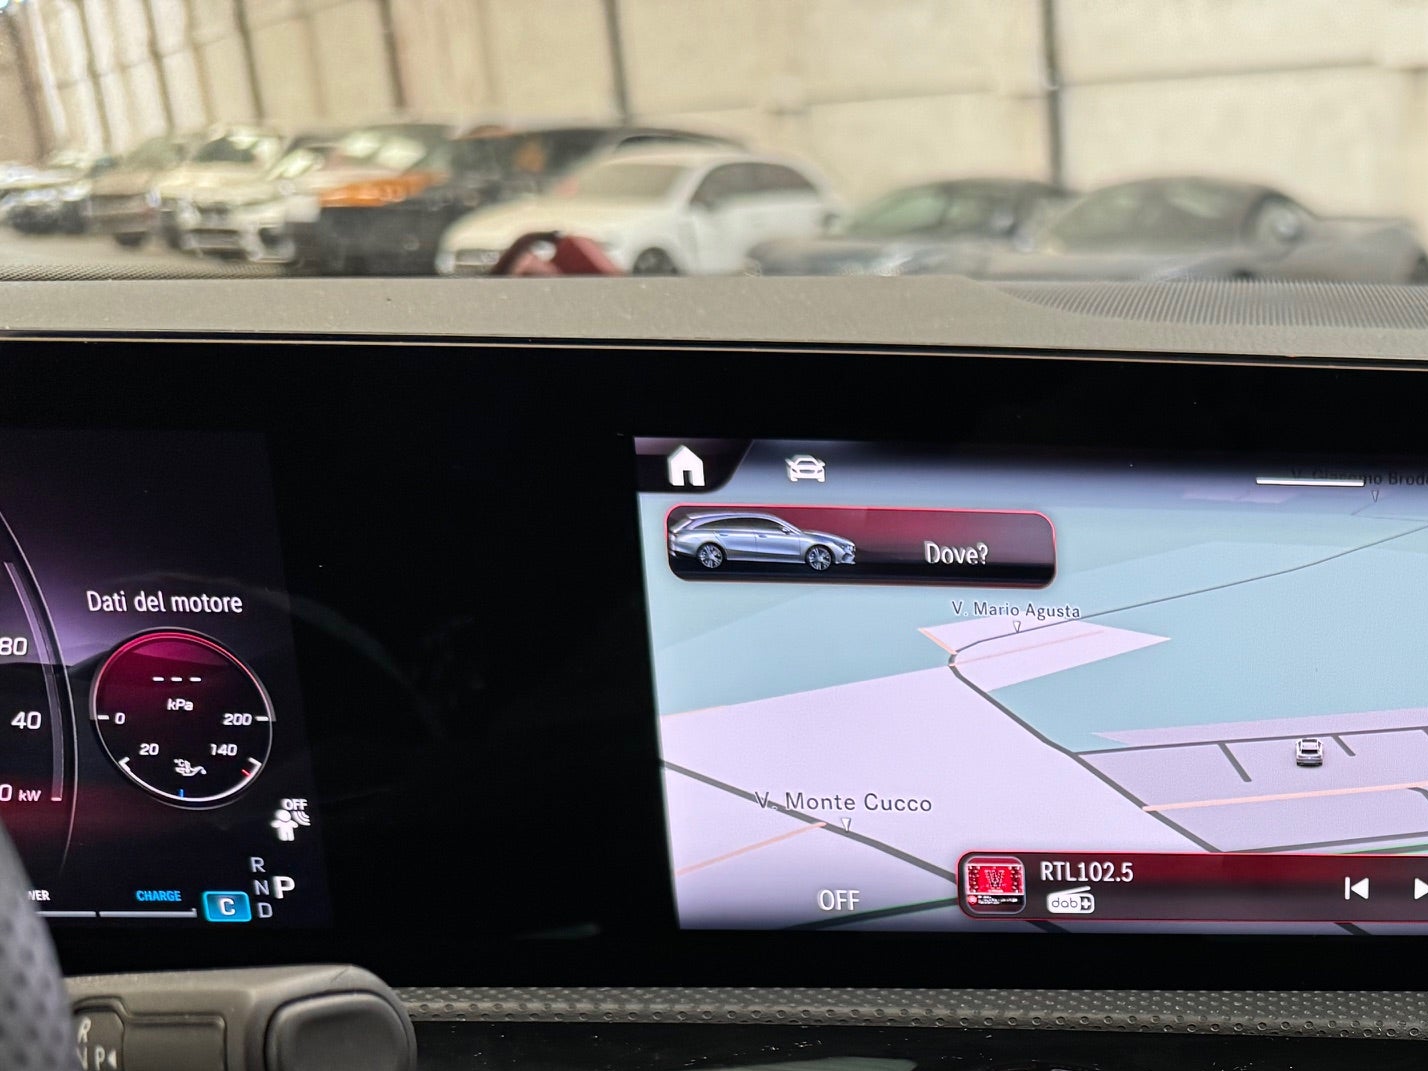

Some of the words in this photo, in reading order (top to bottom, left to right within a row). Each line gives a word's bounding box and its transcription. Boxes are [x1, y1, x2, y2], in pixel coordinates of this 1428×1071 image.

[924, 540, 989, 565] Dove?
[86, 590, 127, 612] Dati
[134, 590, 166, 612] del
[171, 592, 243, 613] motore
[952, 600, 969, 616] V.
[974, 602, 1020, 617] Mario
[1025, 603, 1080, 621] Agusta
[0, 637, 28, 656] 80
[166, 698, 194, 712] kPa
[11, 711, 42, 730] 40
[114, 712, 126, 725] 0
[222, 713, 252, 726] 200
[139, 743, 160, 756] 20
[210, 743, 238, 757] 140
[18, 789, 42, 802] kW
[755, 791, 778, 811] V.
[785, 791, 856, 811] Monte
[863, 792, 933, 812] Cucco
[282, 798, 308, 811] OFF
[250, 856, 266, 873] R
[1040, 861, 1134, 883] RTL102.5
[136, 889, 182, 902] CHARGE
[254, 879, 269, 896] N
[272, 875, 295, 899] P
[217, 897, 236, 916] C
[818, 889, 860, 911] OFF
[257, 902, 274, 918] D
